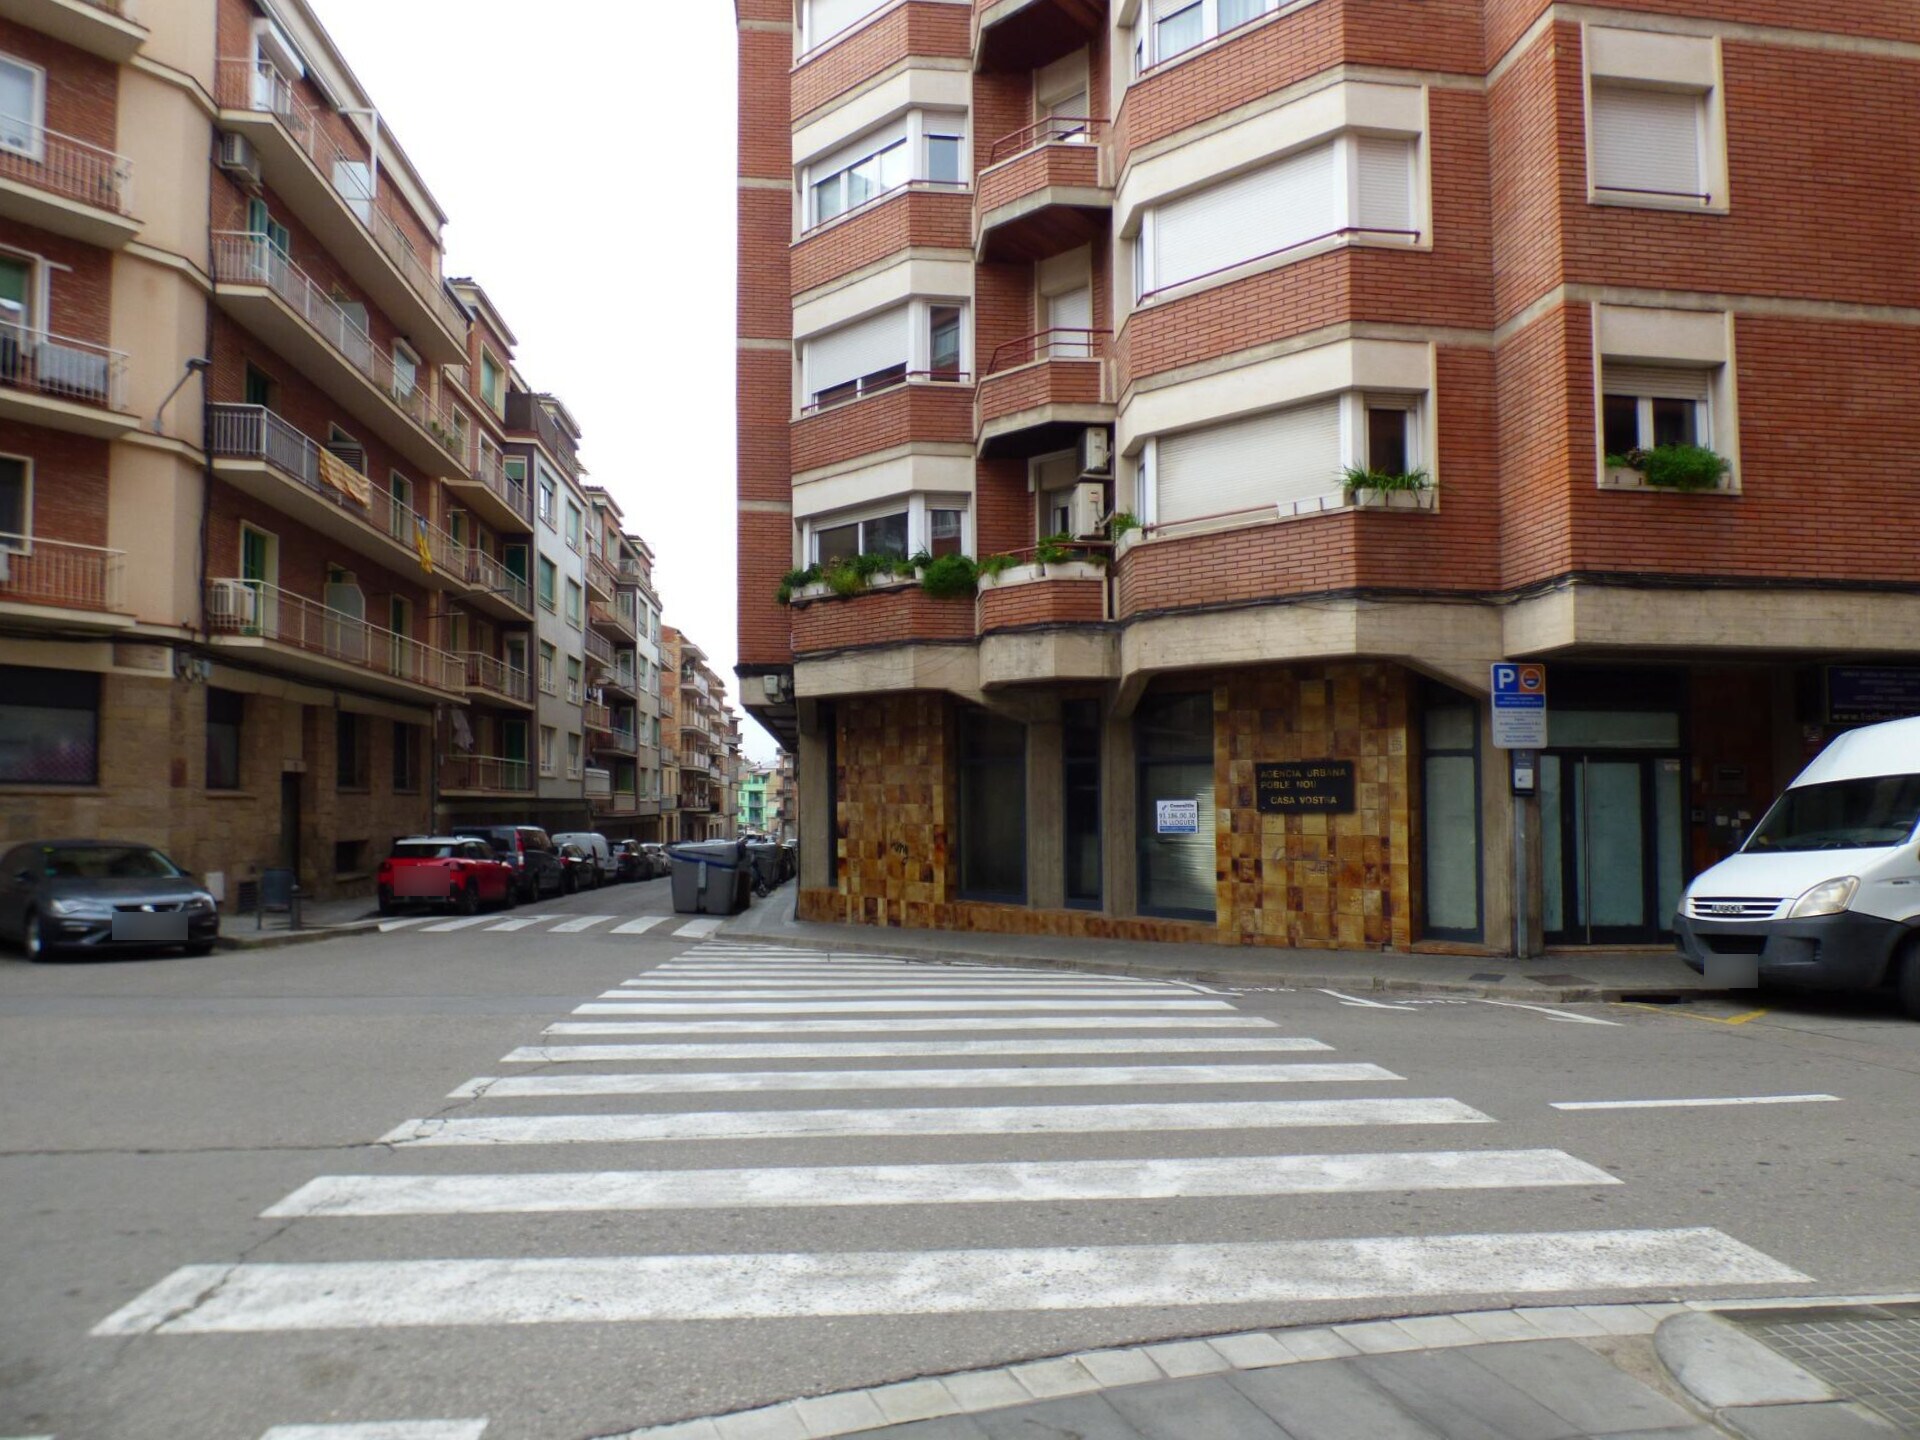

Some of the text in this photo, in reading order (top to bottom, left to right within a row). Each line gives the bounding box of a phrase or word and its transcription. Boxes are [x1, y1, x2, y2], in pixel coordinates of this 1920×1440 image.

[1498, 669, 1515, 689] P
[1260, 768, 1346, 778] AGENCIA URBANA
[1260, 780, 1290, 789] POBLE
[1270, 796, 1295, 805] CASA
[1711, 903, 1744, 914] IVECO
